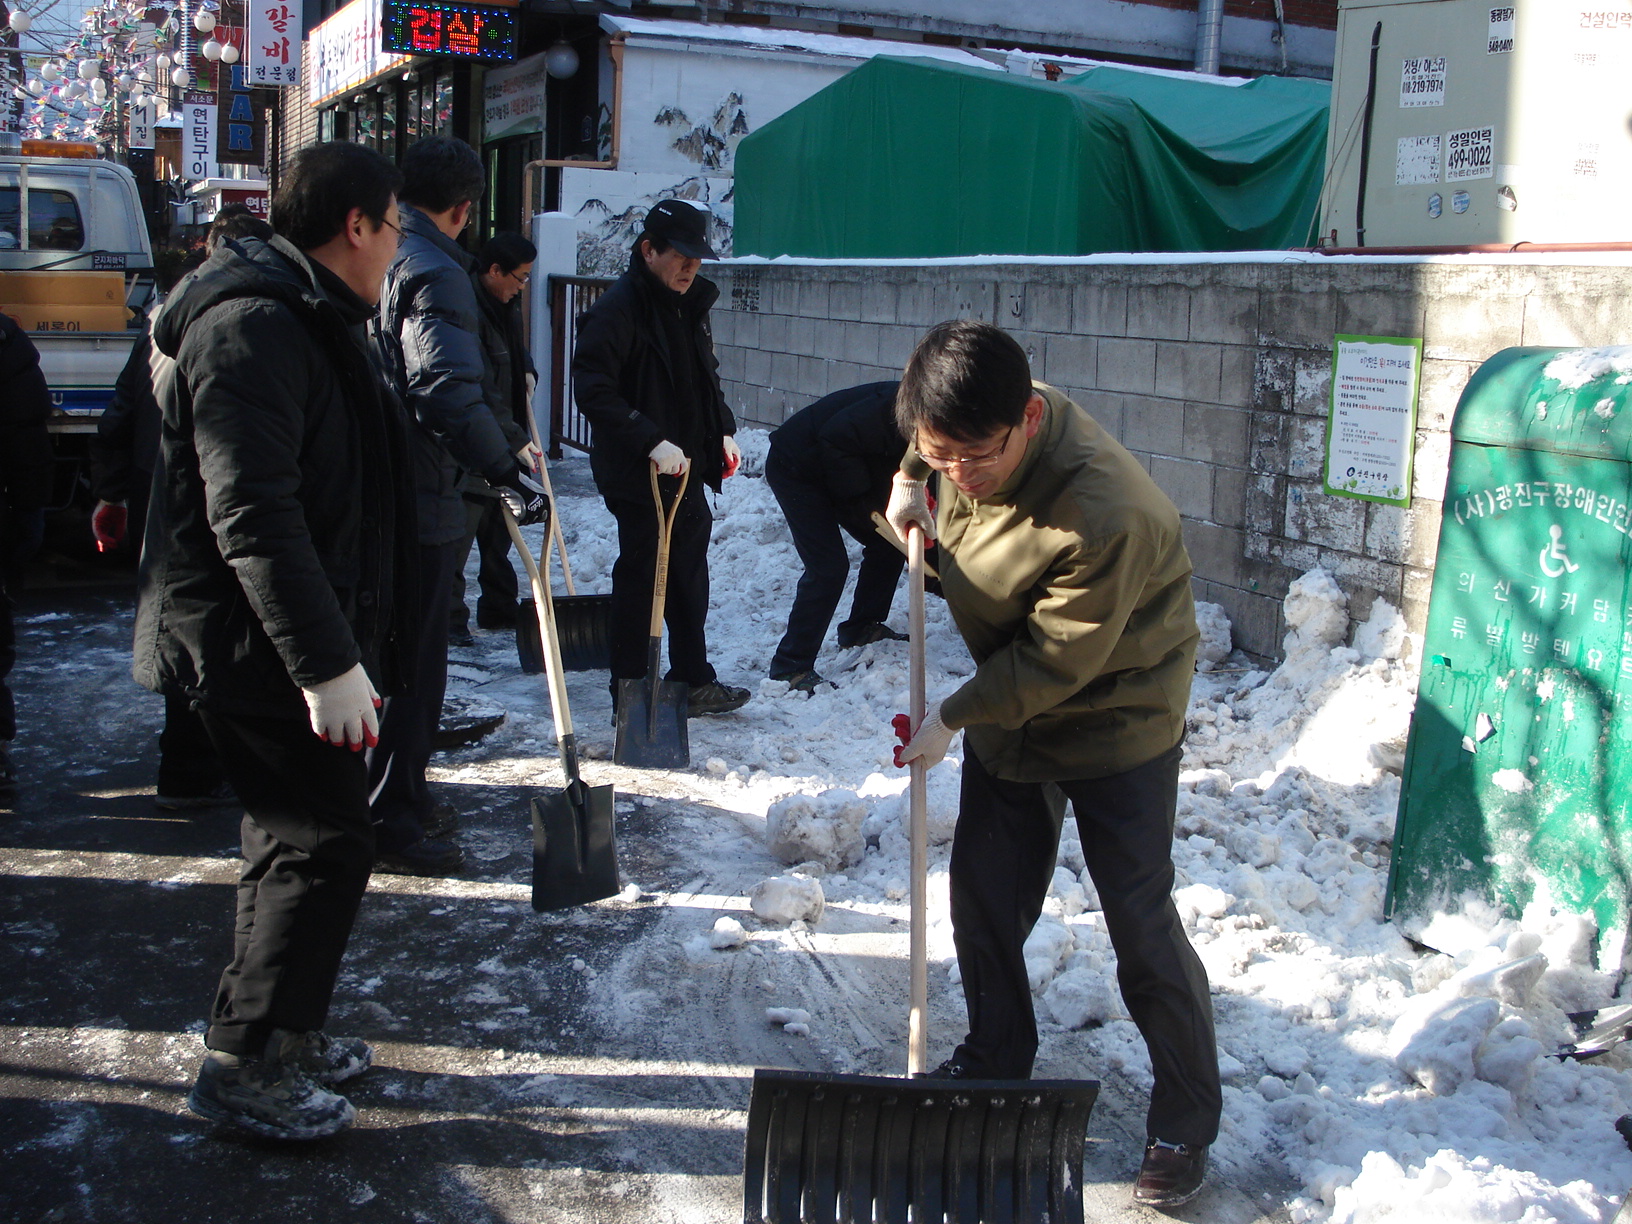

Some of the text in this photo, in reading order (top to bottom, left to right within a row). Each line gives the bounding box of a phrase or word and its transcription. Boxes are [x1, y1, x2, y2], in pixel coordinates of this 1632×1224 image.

[262, 0, 296, 65] 갈비
[255, 65, 296, 82] 전문점
[190, 95, 214, 104] 서소문
[192, 108, 209, 178] 연탄구이
[1449, 129, 1492, 149] 성일인력
[1447, 145, 1491, 170] 499-0022
[1455, 482, 1632, 540] (사)광진구장애인연
